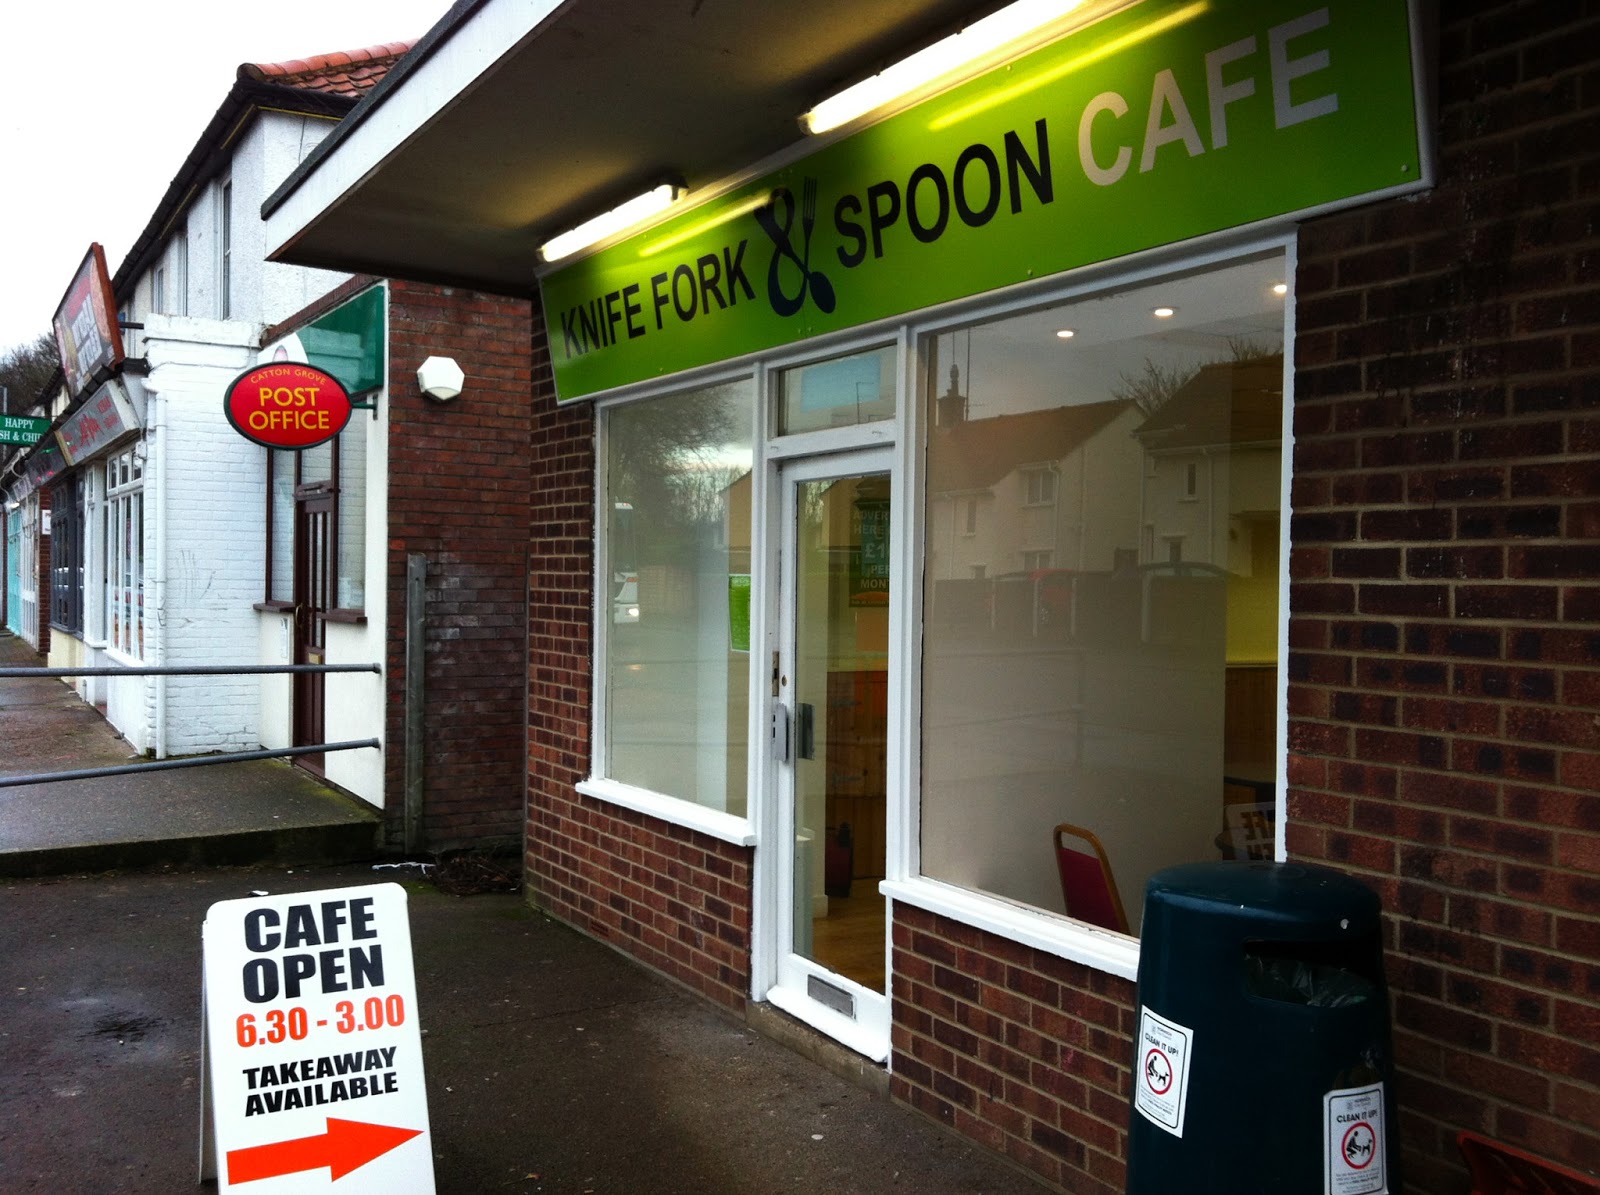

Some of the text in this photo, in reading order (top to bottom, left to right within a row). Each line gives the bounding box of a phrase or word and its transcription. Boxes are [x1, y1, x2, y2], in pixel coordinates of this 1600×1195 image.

[560, 283, 646, 360] KNIFE
[651, 239, 756, 331] FORK
[833, 117, 1054, 269] SPOON
[1077, 6, 1339, 187] CAFE
[251, 368, 327, 386] CATTON GROVE
[259, 387, 320, 407] POST
[4, 417, 35, 430] HAPPY
[248, 410, 330, 430] OFFICE
[13, 431, 20, 441] &
[243, 896, 378, 953] CAFE
[242, 944, 385, 1004] OPEN
[235, 1006, 309, 1048] 6.30
[335, 994, 405, 1034] 3.00
[1145, 1032, 1161, 1047] CLEAN
[1161, 1042, 1167, 1051] IT
[242, 1046, 398, 1090] TAKEAWAY
[244, 1071, 399, 1118] AVAILABLE
[1336, 1112, 1360, 1123] CLEAN
[1361, 1111, 1367, 1120] IT
